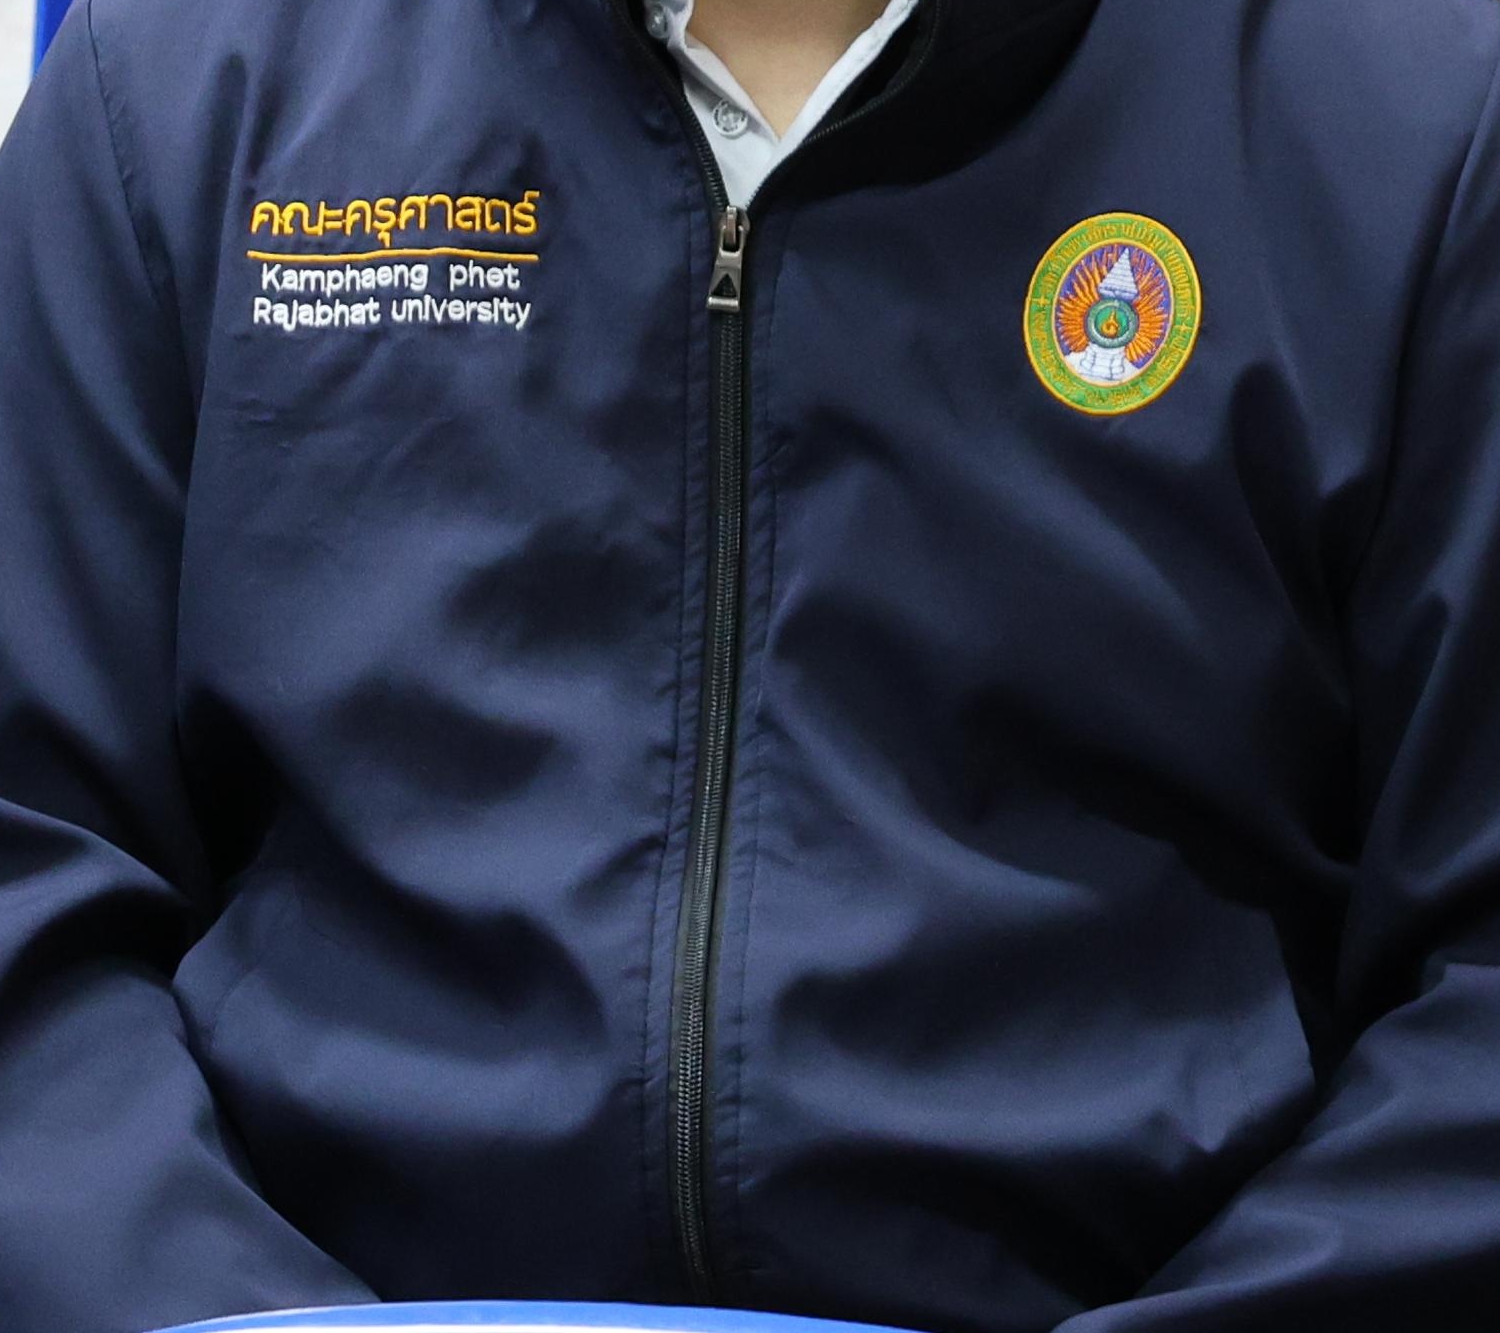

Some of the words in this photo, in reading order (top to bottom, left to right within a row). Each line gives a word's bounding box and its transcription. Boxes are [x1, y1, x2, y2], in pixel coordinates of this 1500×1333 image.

[251, 190, 540, 247] คณะครุศาสตร์
[261, 263, 429, 297] Kamphaeng
[449, 260, 520, 291] phet
[253, 297, 381, 333] Rajabhat
[391, 294, 531, 330] university
